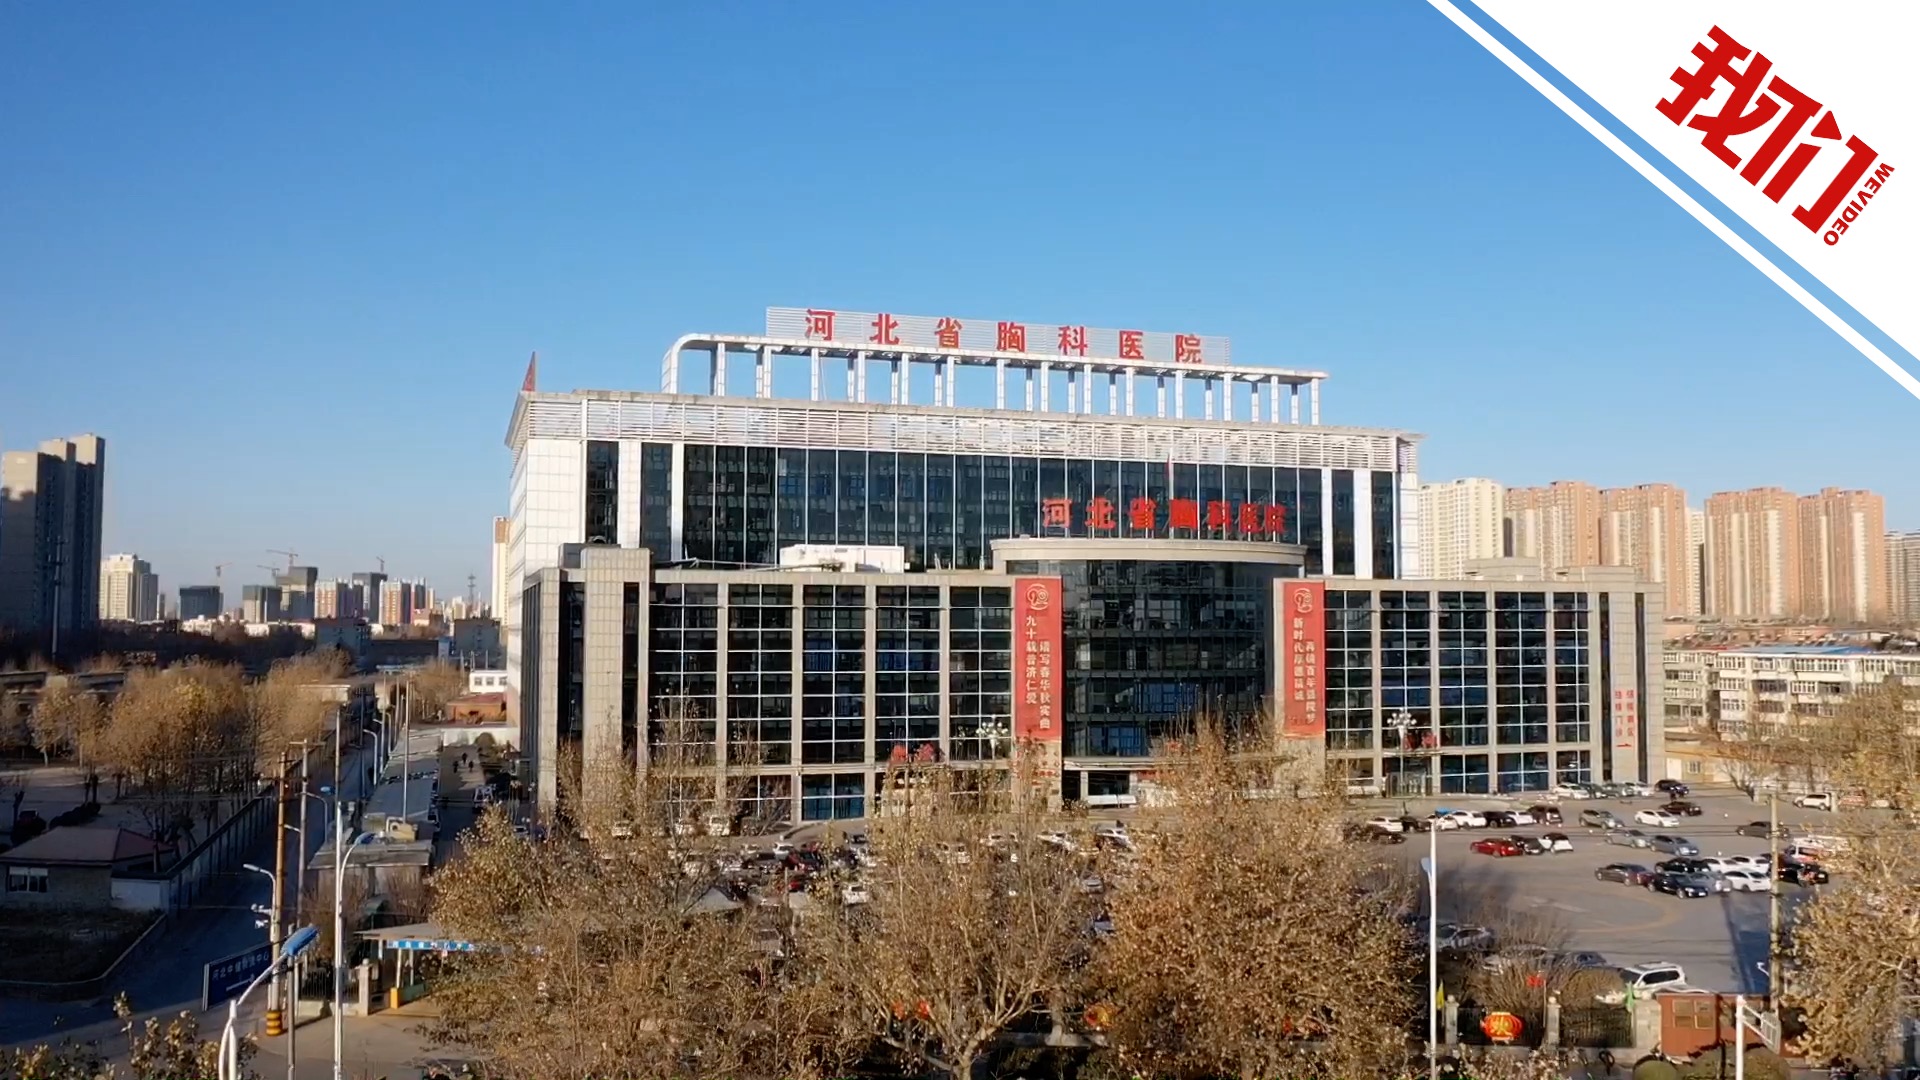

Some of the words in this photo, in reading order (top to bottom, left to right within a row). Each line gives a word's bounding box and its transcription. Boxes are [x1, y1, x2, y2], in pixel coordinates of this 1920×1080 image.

[804, 309, 1203, 363] 河北省胸科医院
[1042, 497, 1286, 534] 河北省胸科医院
[1025, 615, 1038, 704] 九十载普济仁爱
